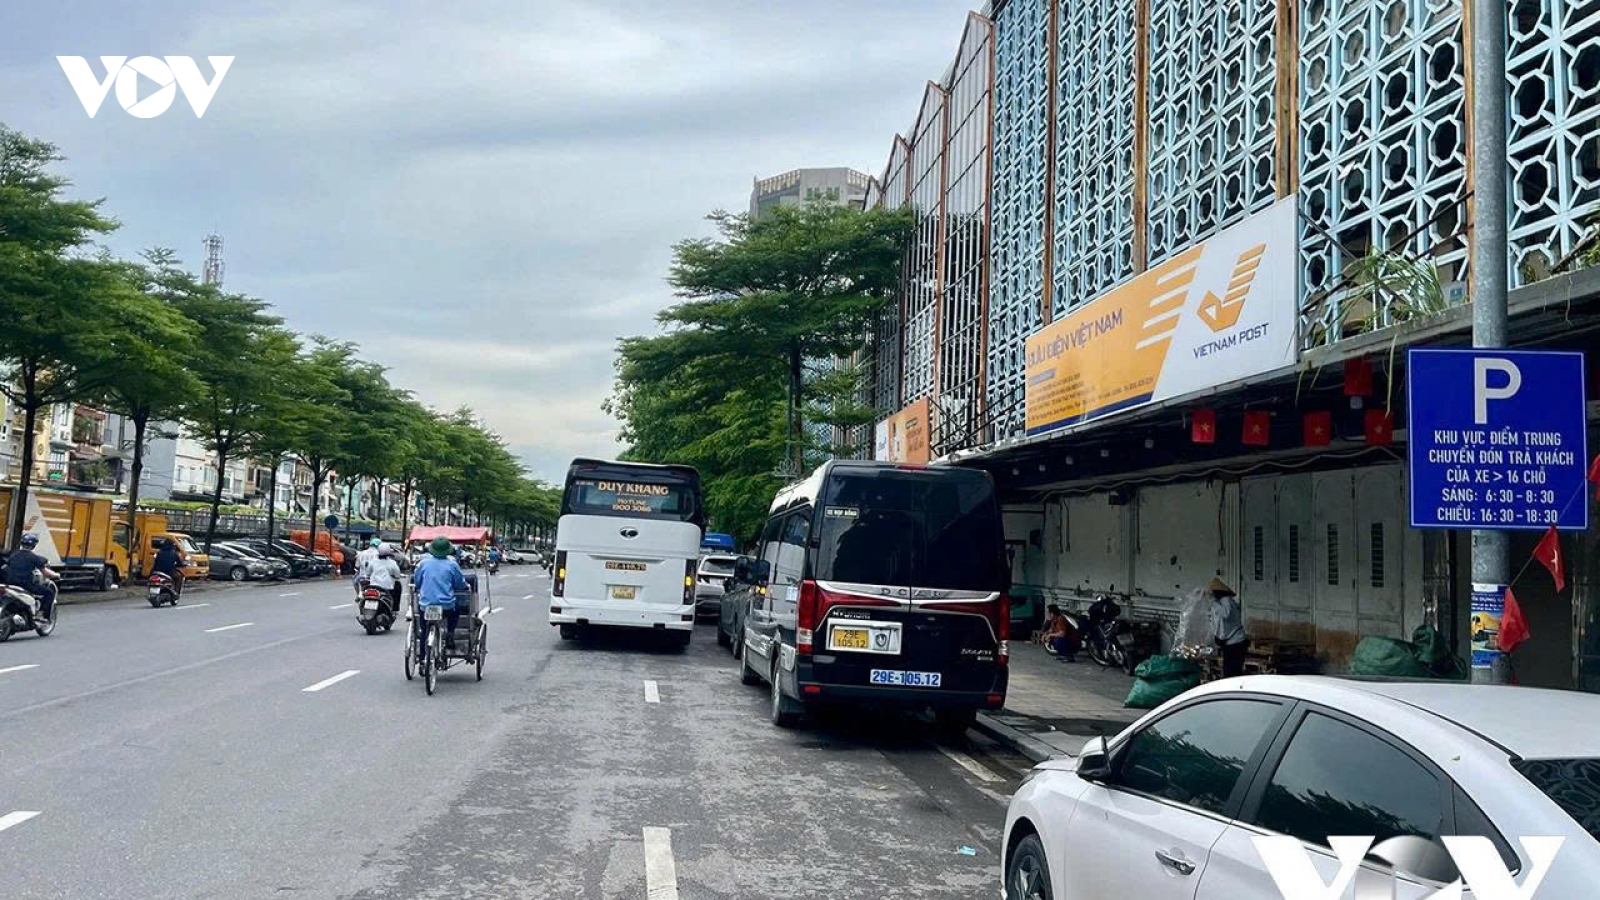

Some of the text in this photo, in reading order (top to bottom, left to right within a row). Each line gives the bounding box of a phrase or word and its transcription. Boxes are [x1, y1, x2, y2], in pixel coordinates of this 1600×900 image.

[1070, 321, 1094, 349] VIỆT
[1094, 307, 1123, 337] NAM
[1193, 322, 1269, 359] VIETNAM POST
[1474, 357, 1522, 424] P
[1434, 426, 1561, 448] KHU VỰC ĐIỂM TRUNG
[1429, 445, 1574, 465] CHUYỂN ĐÓN TRẢ KHÁCH
[1447, 465, 1470, 482] CỦA
[1475, 470, 1490, 482] XE
[1508, 470, 1519, 483] 16
[1523, 466, 1546, 484] CHỖ
[599, 481, 625, 492] DUY
[626, 483, 669, 495] KHANG
[1442, 484, 1478, 502] SÁNG:
[1437, 503, 1476, 521] CHIỀU:
[837, 638, 866, 648] 105.12
[843, 629, 860, 639] 29E
[872, 670, 940, 686] 29E-105.12
